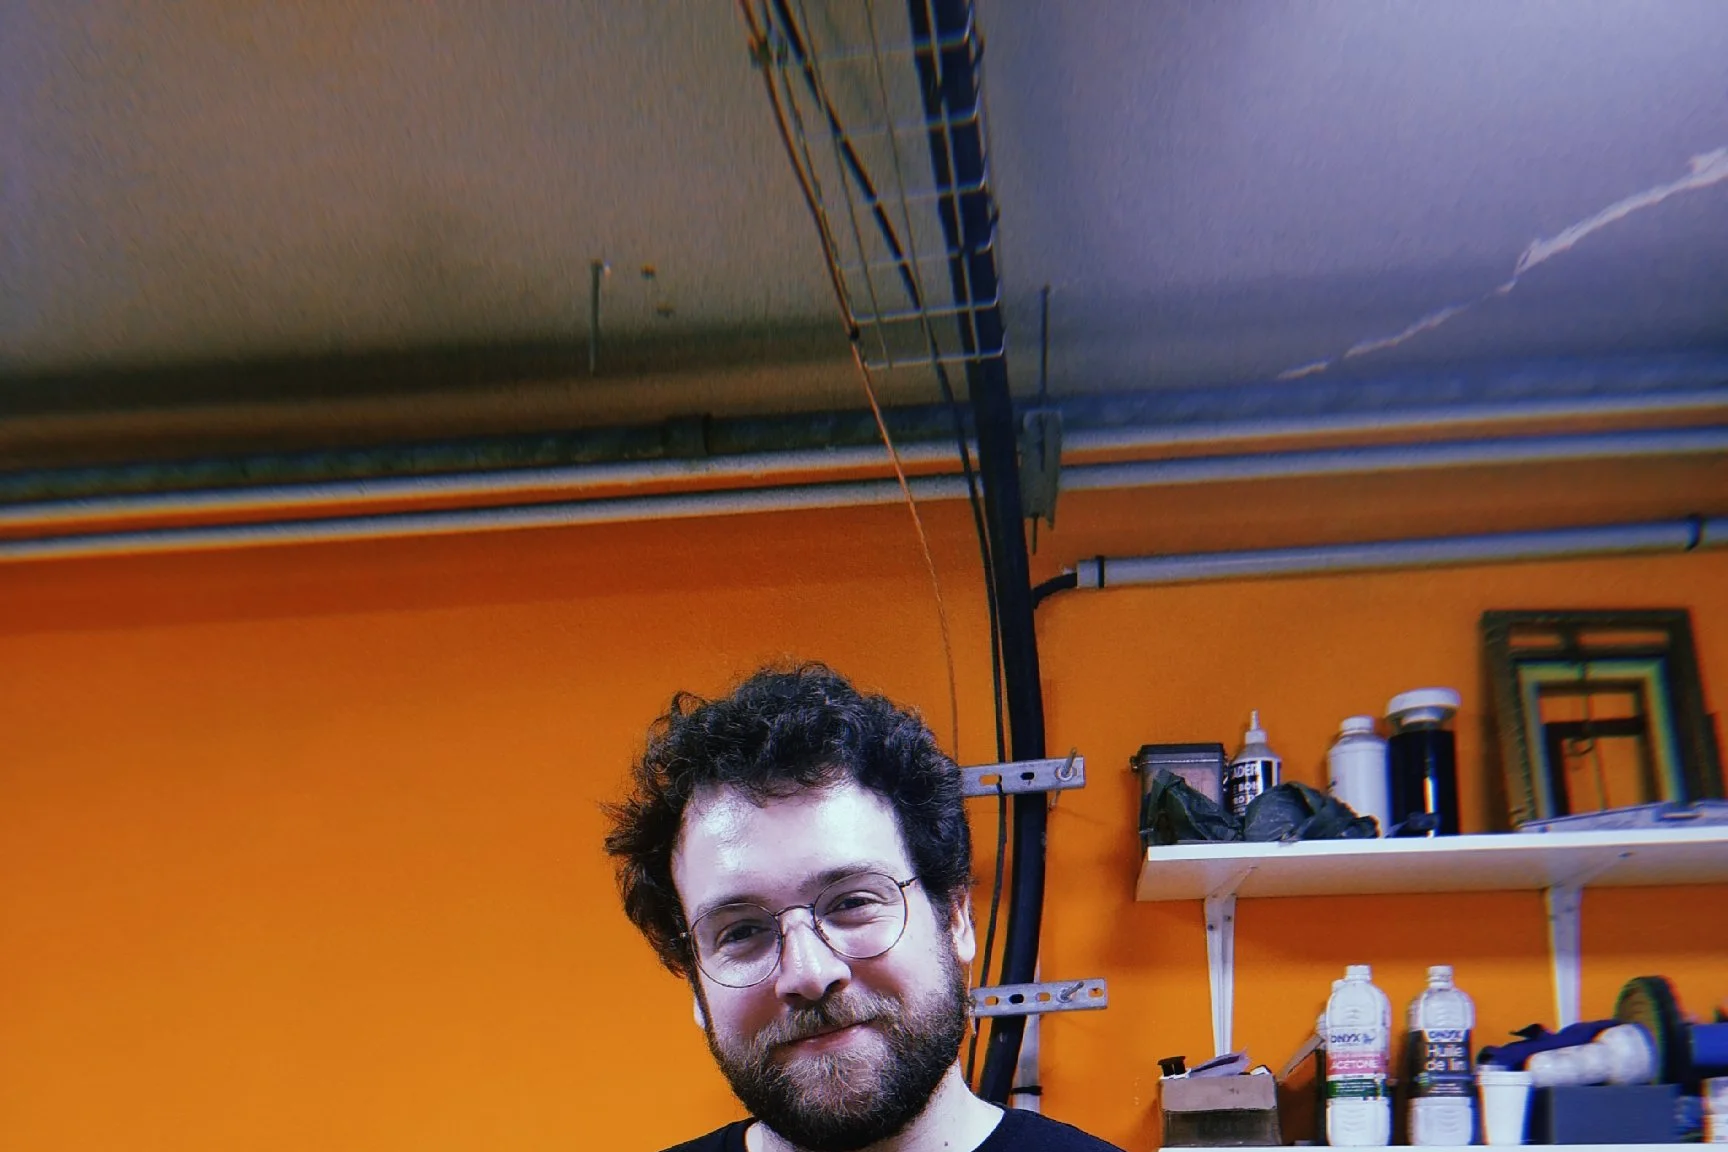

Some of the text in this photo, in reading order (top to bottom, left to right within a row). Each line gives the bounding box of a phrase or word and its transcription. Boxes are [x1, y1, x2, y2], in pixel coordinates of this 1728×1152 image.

[1331, 1033, 1361, 1044] ONYX
[1424, 1044, 1464, 1058] Huile
[1424, 1057, 1467, 1071] de lin
